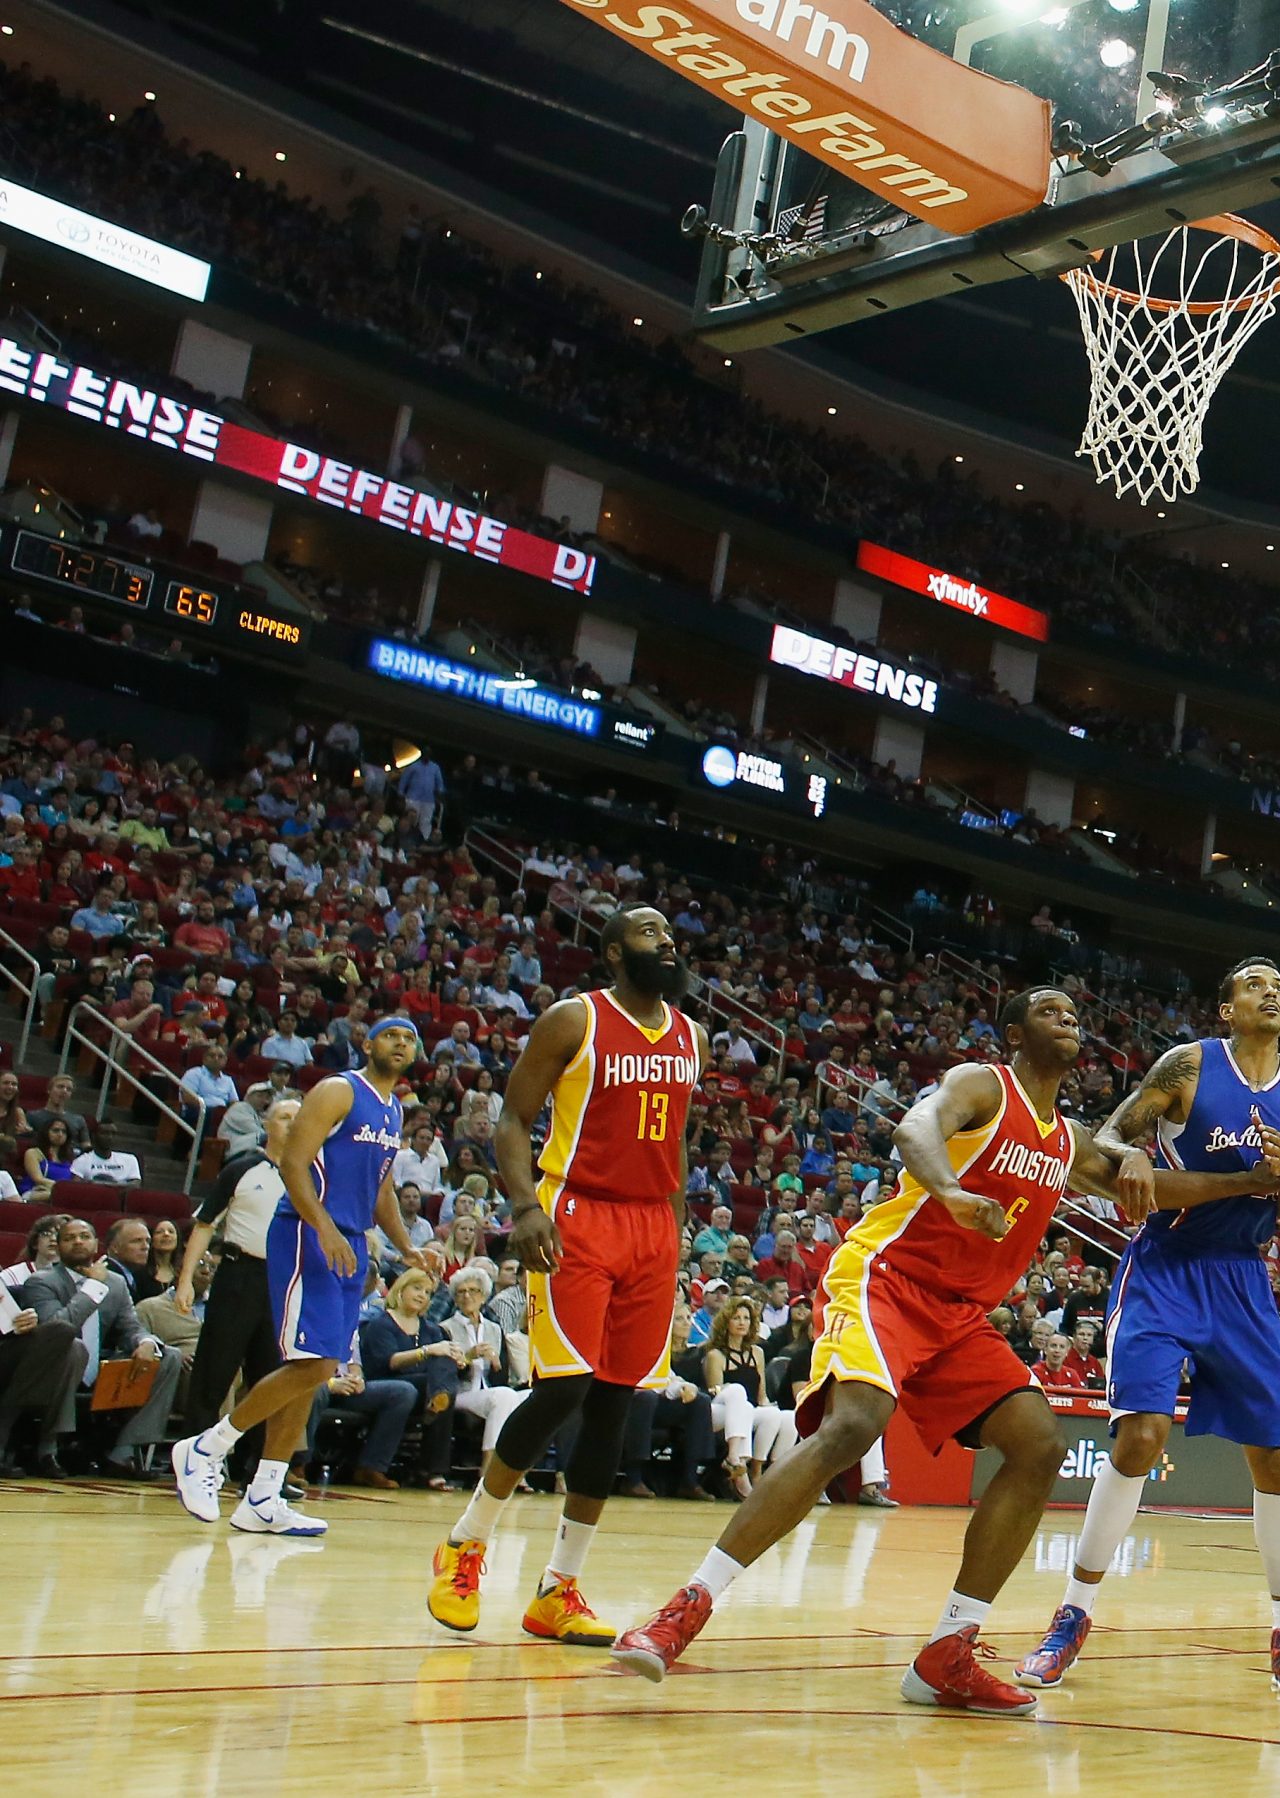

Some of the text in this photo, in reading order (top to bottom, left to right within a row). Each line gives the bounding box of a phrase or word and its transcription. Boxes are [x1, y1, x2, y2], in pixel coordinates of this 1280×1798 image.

[735, 0, 870, 83] arm
[605, 6, 968, 208] State Farm
[97, 231, 161, 265] TOYOTA
[277, 442, 507, 564] DEFENSE
[127, 577, 142, 602] 3
[176, 586, 212, 622] 65
[239, 611, 300, 644] CLIPPERS
[378, 643, 595, 731] BRING THE ENERGY!
[777, 627, 938, 713] DEFENSE
[614, 721, 648, 742] reliant
[604, 1053, 695, 1089] HOUSTON
[637, 1090, 669, 1142] 13
[1205, 1126, 1239, 1152] Los
[987, 1138, 1067, 1193] HOUSTON
[1058, 1438, 1111, 1479] elia
